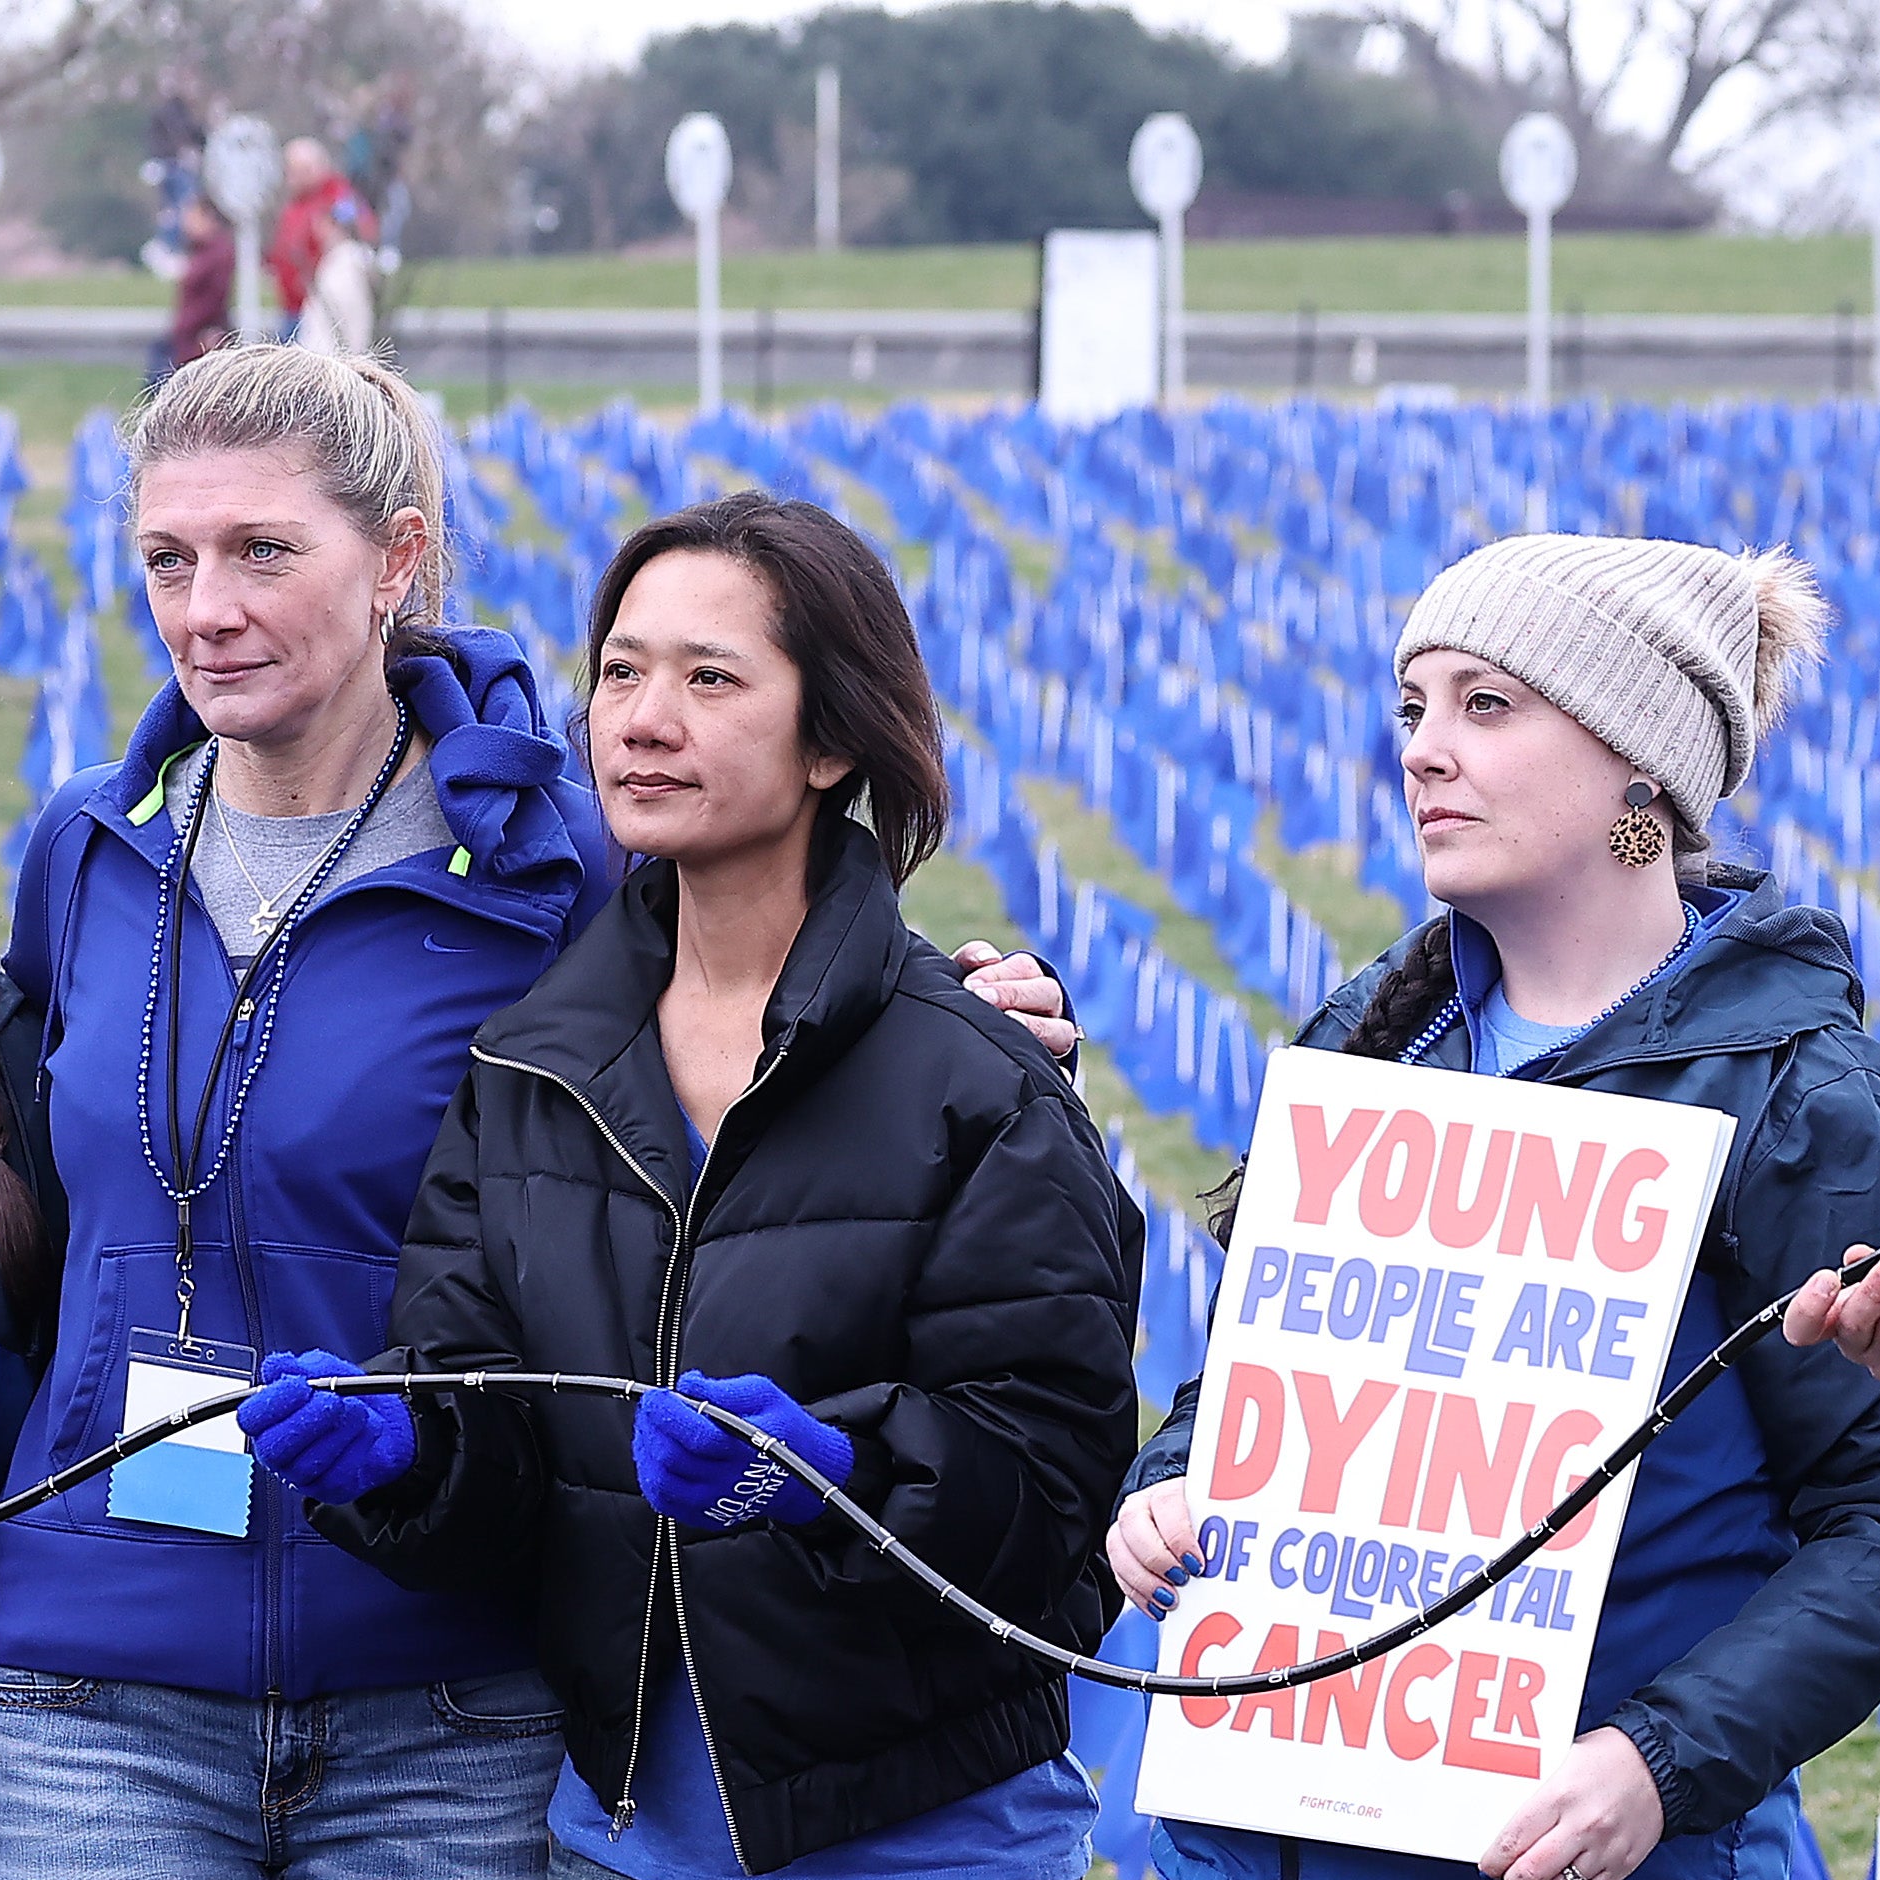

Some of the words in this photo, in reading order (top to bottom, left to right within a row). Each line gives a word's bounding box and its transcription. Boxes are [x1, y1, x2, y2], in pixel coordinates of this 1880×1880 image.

[1288, 1103, 1670, 1273] YOUNG
[1239, 1245, 1483, 1377] PEOPLE
[1496, 1283, 1648, 1381] ARE
[1208, 1361, 1605, 1552] DYING
[1199, 1515, 1258, 1582] OF
[1270, 1525, 1574, 1632] COLORECTAL
[1179, 1611, 1546, 1780] CANCER
